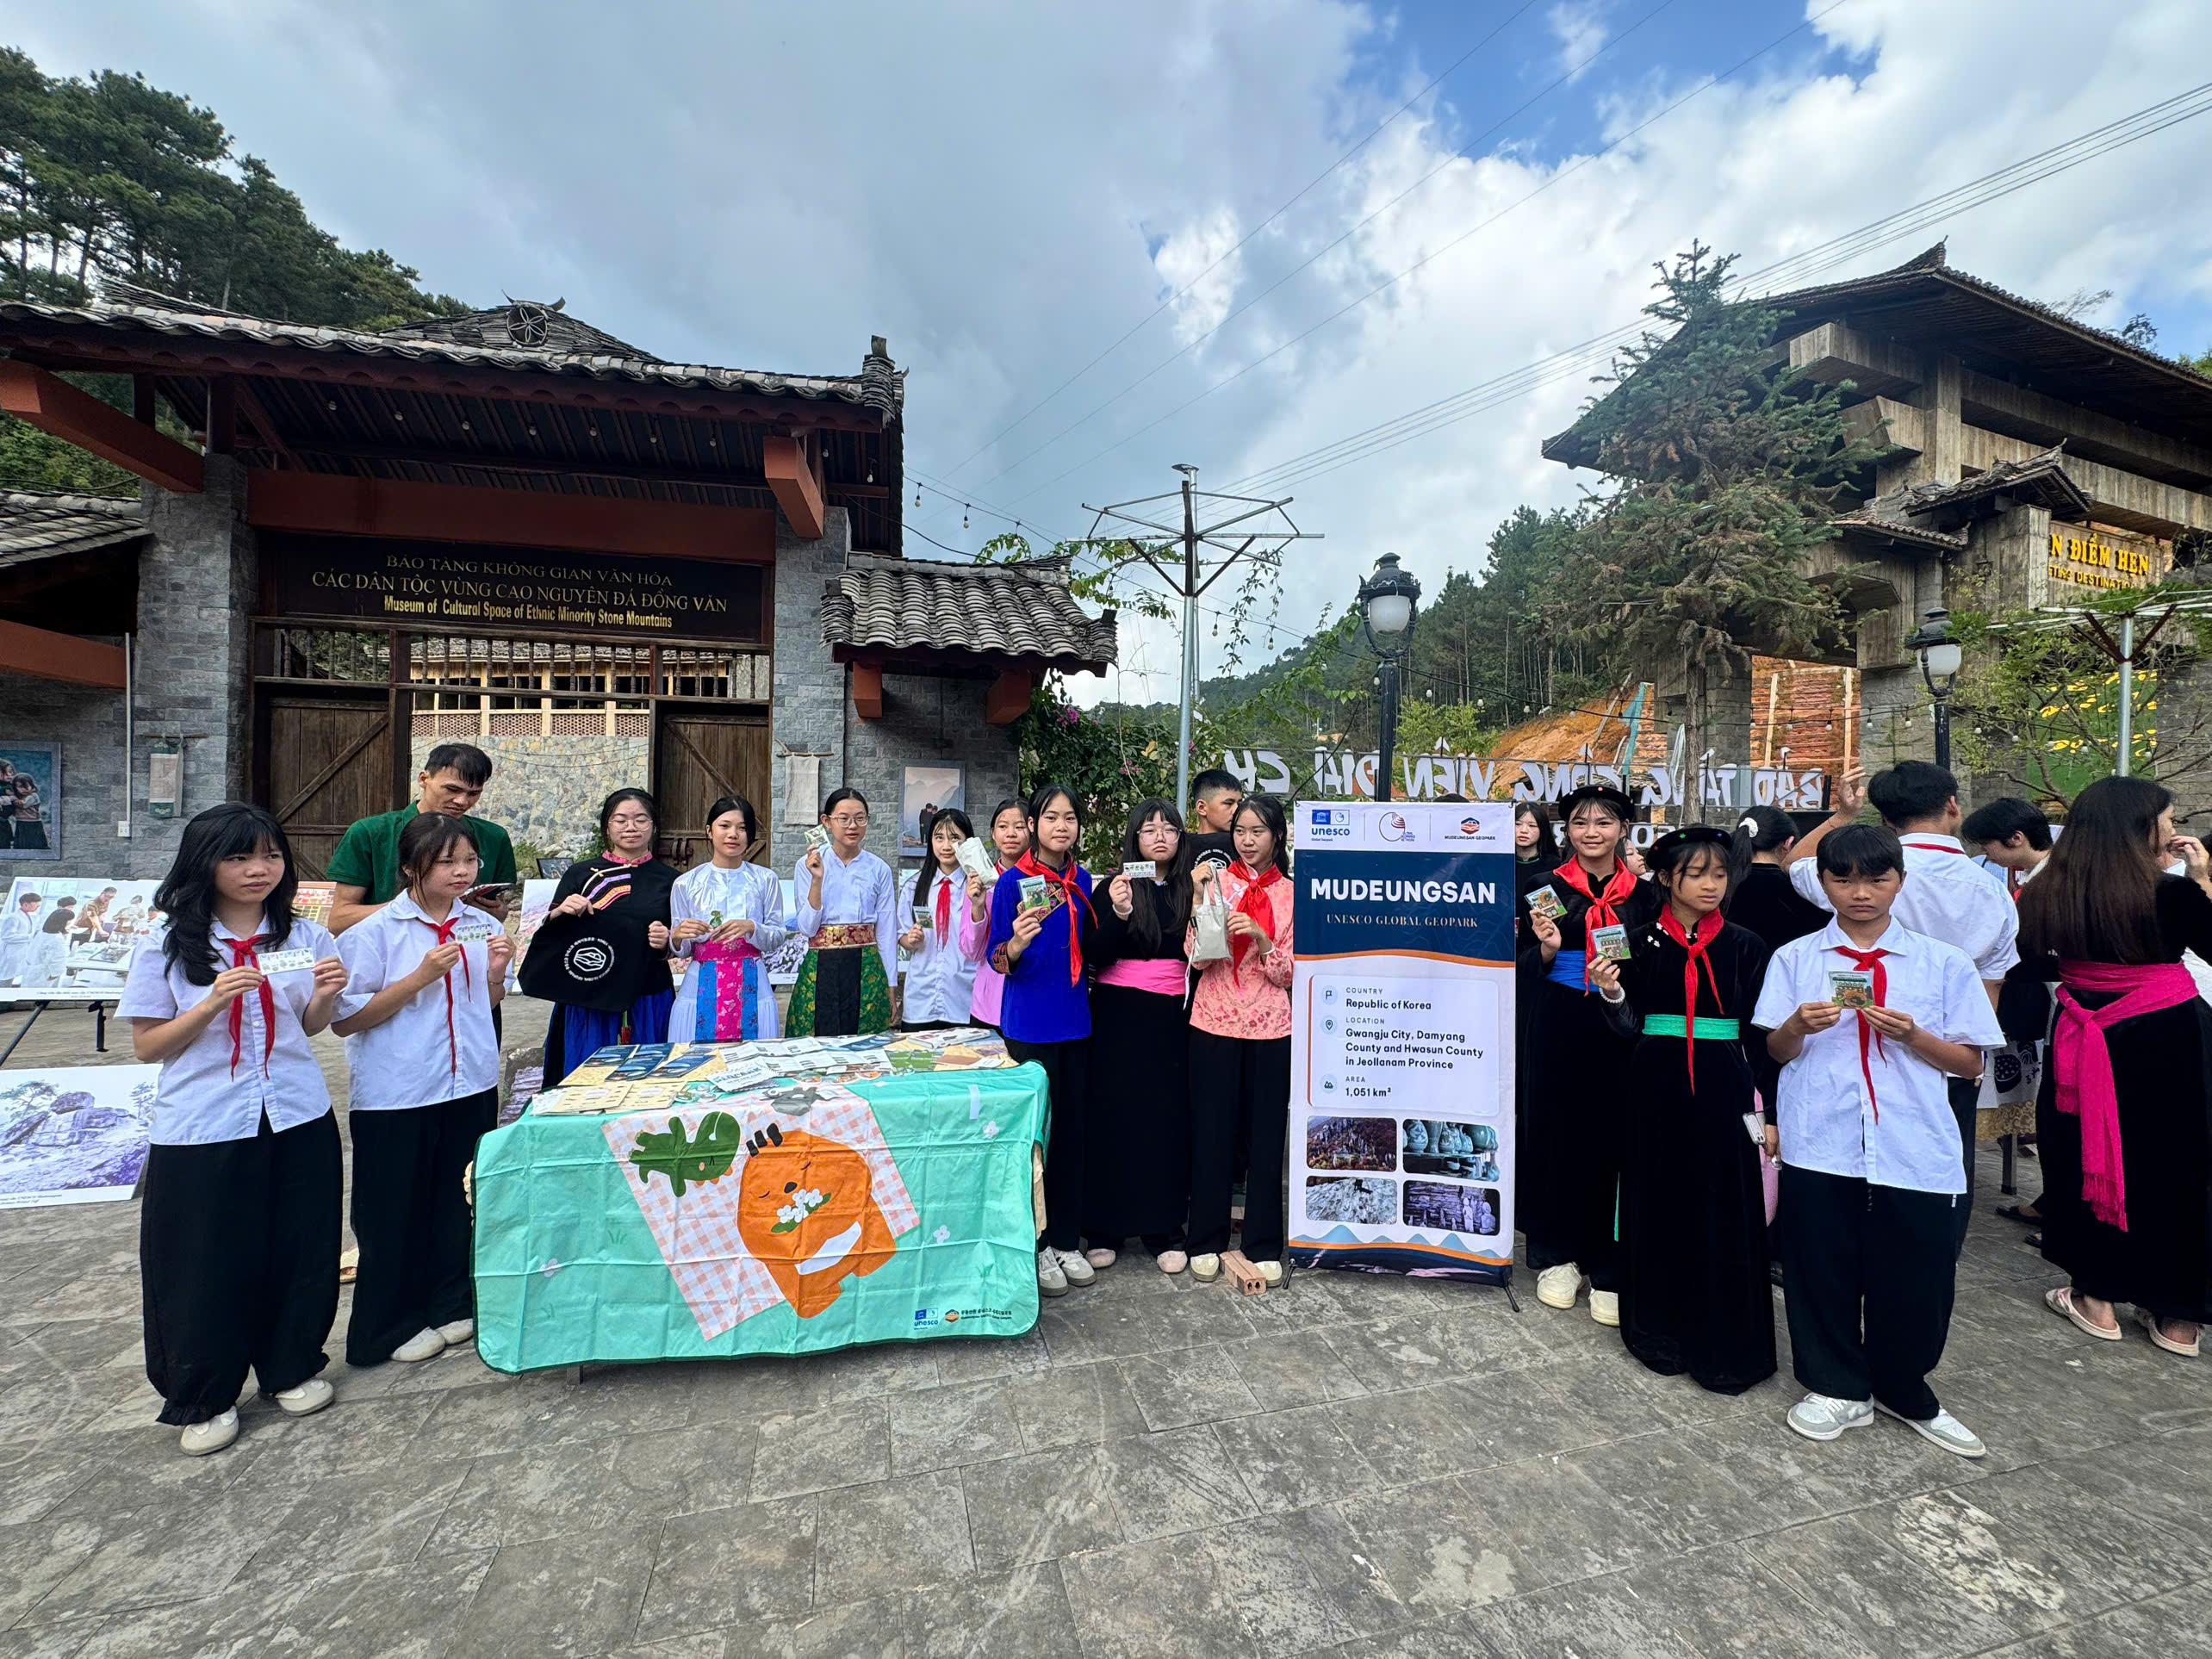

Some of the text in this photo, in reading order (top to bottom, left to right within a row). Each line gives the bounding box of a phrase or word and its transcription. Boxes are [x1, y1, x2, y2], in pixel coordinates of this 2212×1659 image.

[2070, 532, 2110, 568] ĐIỂM
[430, 556, 478, 573] TÀNG
[550, 567, 592, 581] GIAN
[597, 568, 633, 583] VĂN
[312, 568, 351, 588] CÁC
[355, 570, 395, 591] DÂN
[400, 574, 436, 595] TỘC
[440, 576, 491, 599] VÙNG
[537, 586, 609, 606] NGUYÊN
[613, 587, 637, 606] ĐÁ
[641, 587, 688, 610] ĐỒNG
[693, 594, 727, 612] VĂN
[384, 595, 673, 628] Museum of Cultural Space of Ethnic Minority Stone Mountains
[1311, 828, 1351, 836] unesco
[1310, 878, 1495, 904] MUDEUNGSAN
[1327, 913, 1478, 928] UNESCO GLOBAL GEOPARK
[1345, 998, 1432, 1011] Republic of Korea
[1345, 1028, 1466, 1043] Gwangju City, Damyang
[1345, 1042, 1484, 1058] County and Hwasun County
[1345, 1056, 1453, 1069] in Jeollanam Province
[1345, 1087, 1392, 1097] 1,051 km²
